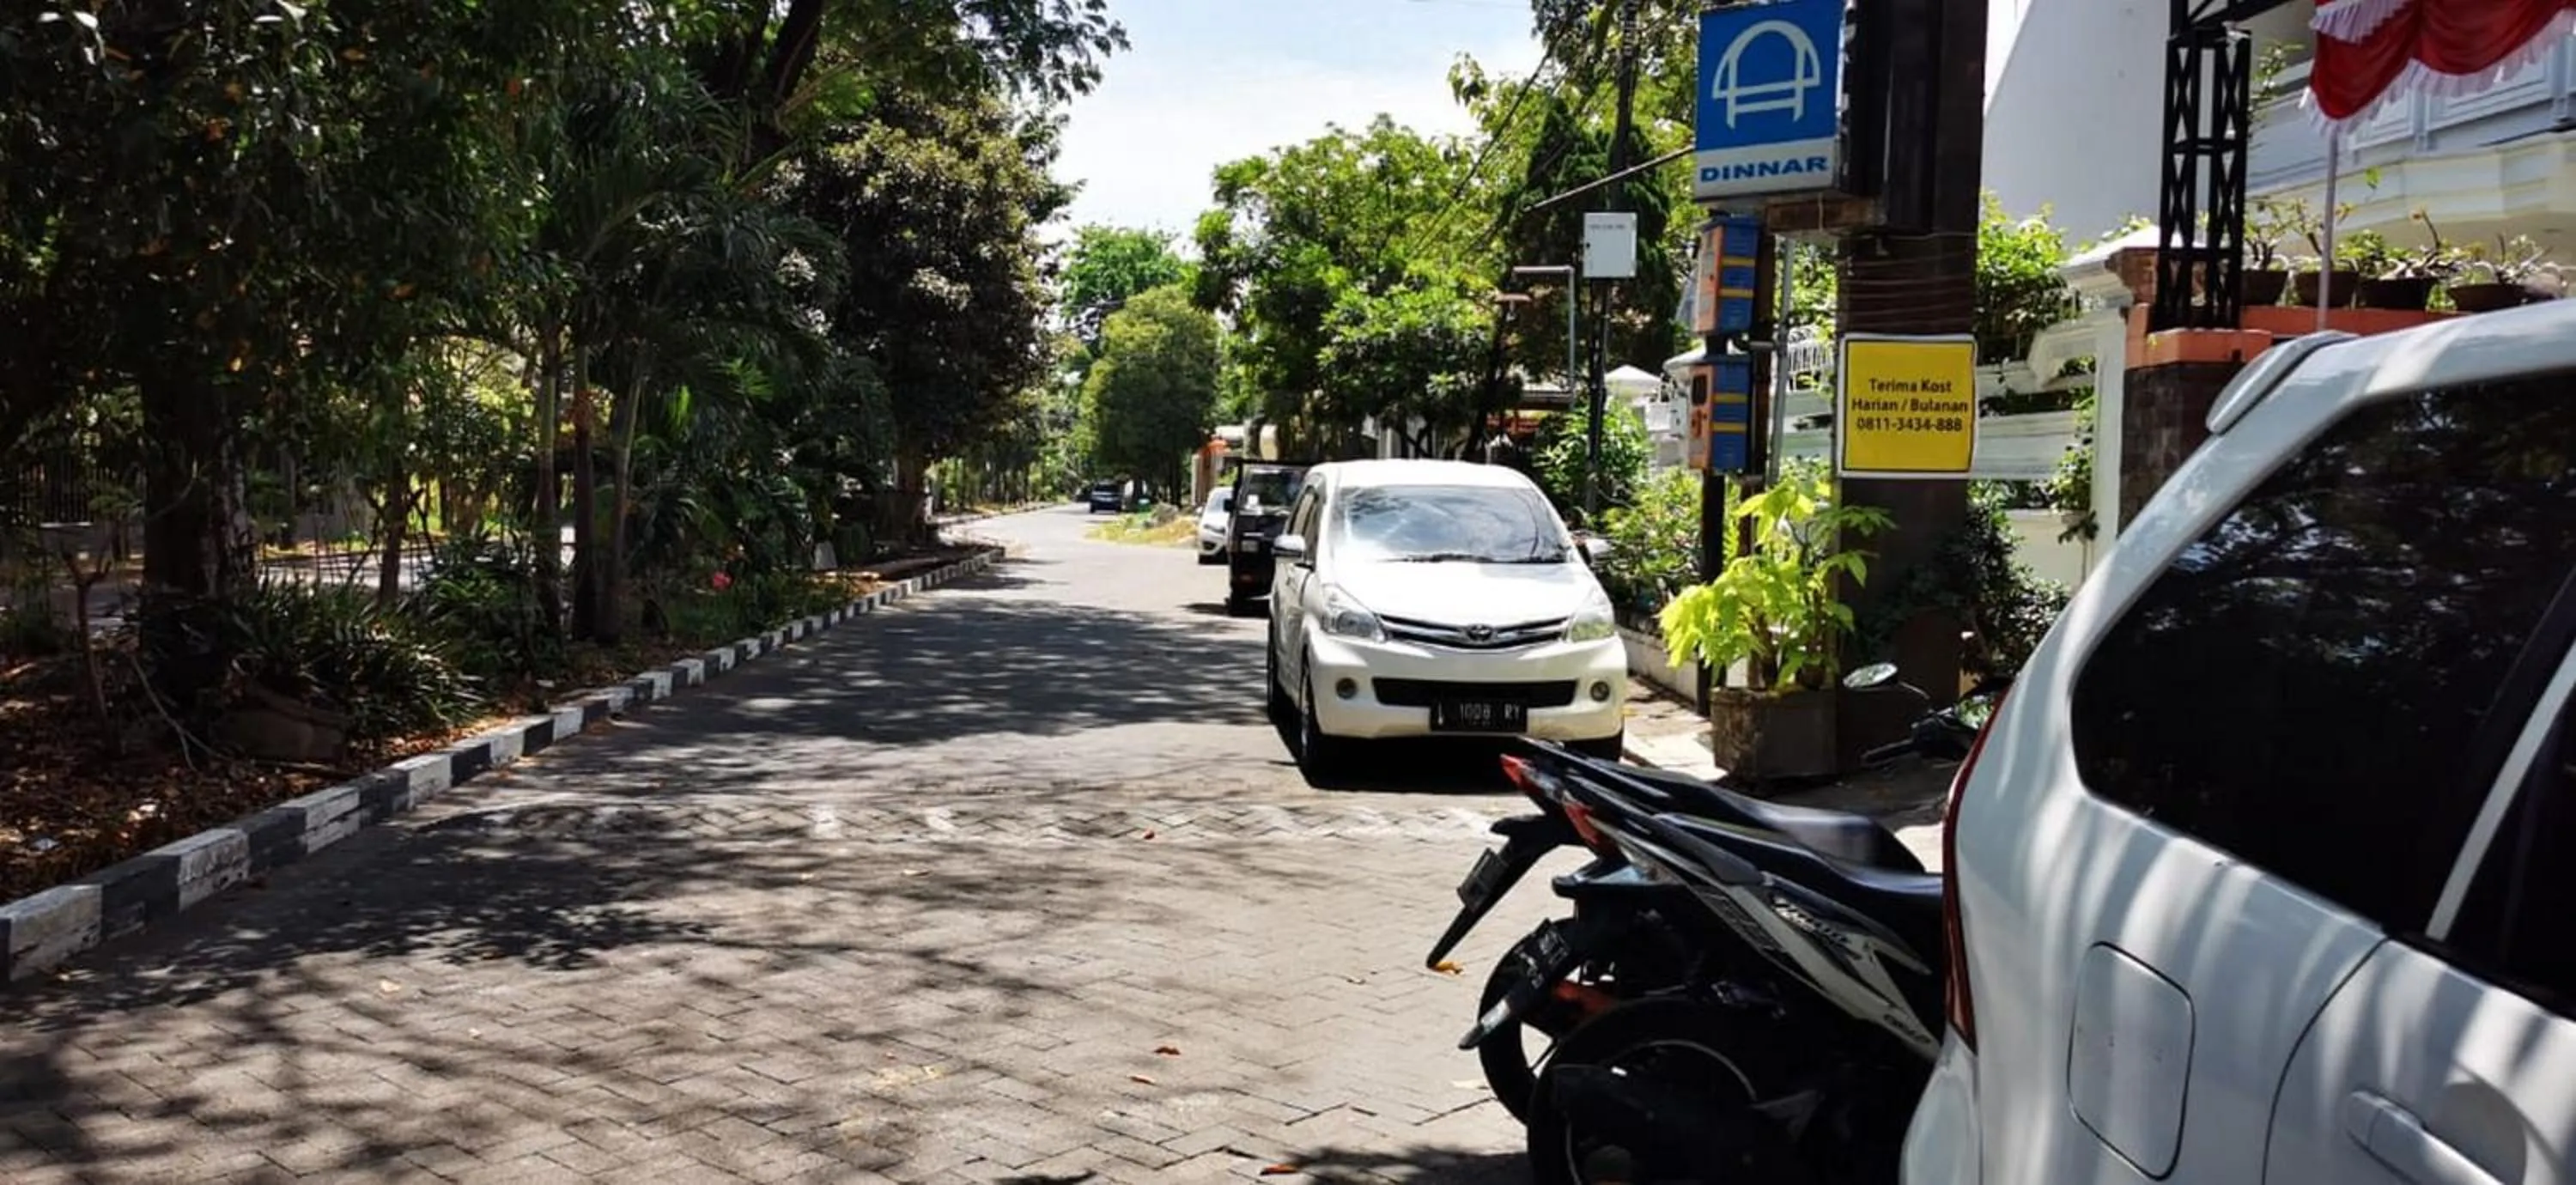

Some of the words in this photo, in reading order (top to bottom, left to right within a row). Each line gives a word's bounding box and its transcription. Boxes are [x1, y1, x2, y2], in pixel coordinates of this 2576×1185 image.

[1701, 156, 1827, 182] DINNAR
[1869, 378, 1917, 392] Terima
[1921, 378, 1952, 392] Kost
[1852, 398, 1898, 411] Harian
[1910, 398, 1968, 412] Bulanan
[1856, 417, 1963, 431] 0811-3434-888
